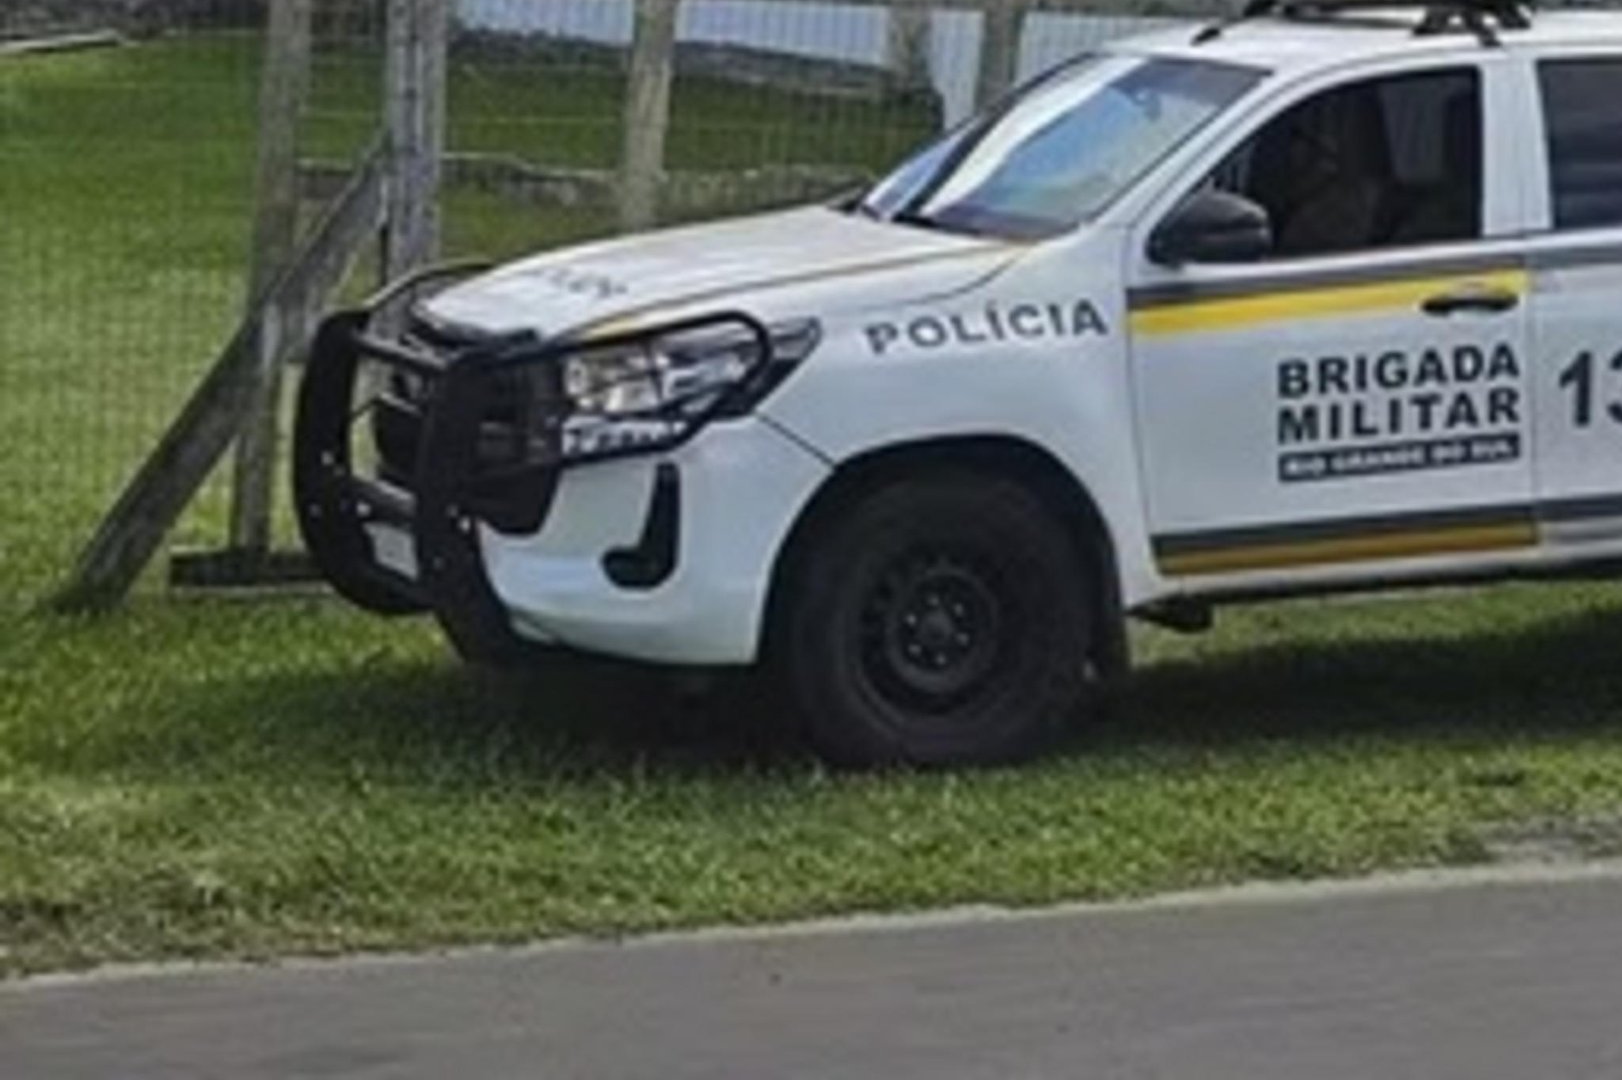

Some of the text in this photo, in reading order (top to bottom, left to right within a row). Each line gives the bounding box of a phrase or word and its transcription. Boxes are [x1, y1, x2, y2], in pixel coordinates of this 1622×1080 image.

[865, 298, 1109, 354] POLÍCIA
[1277, 343, 1520, 398] BRIGADA
[1277, 386, 1520, 446] MILITAR
